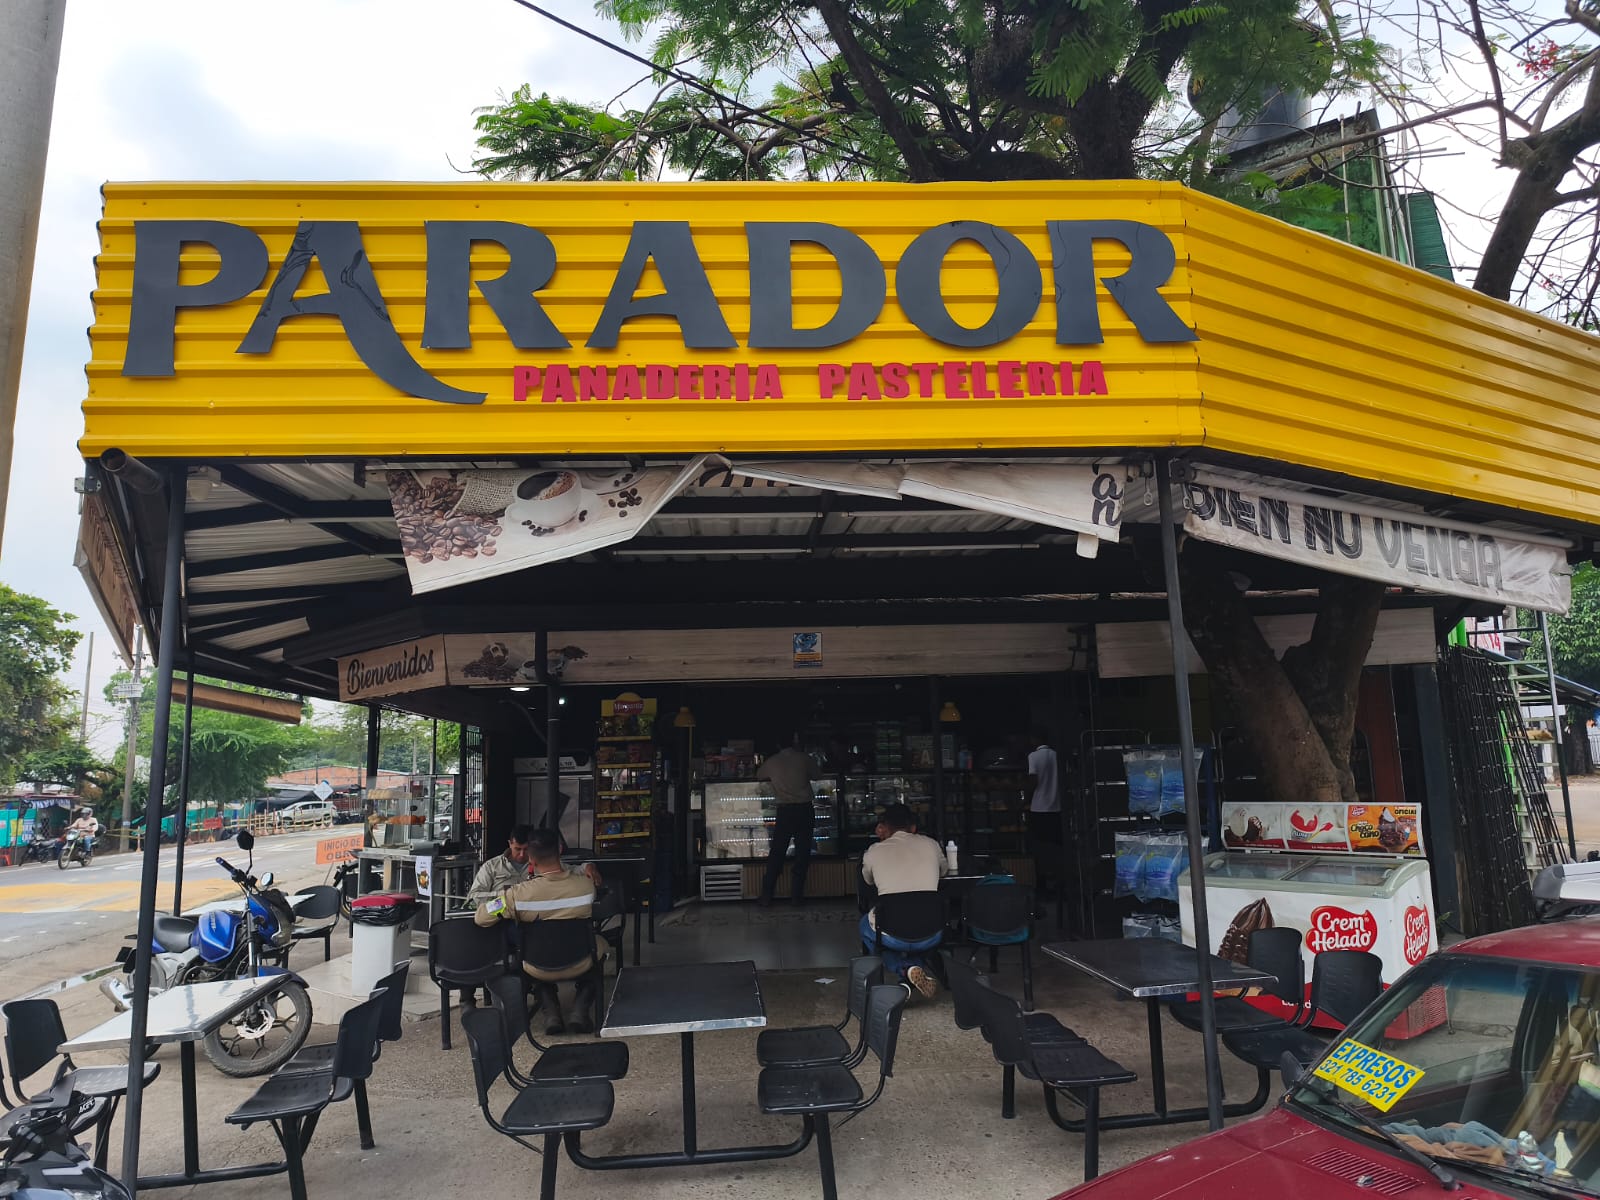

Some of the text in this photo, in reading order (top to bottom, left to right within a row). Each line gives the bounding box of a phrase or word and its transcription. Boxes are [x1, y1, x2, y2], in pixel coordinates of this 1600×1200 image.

[122, 219, 1200, 404] PARADOR
[513, 361, 1109, 402] PANADERIA PASTELERIA
[1373, 517, 1504, 592] VENGA
[346, 644, 435, 695] Bienvenidos
[323, 837, 361, 852] INICIO DE
[1311, 929, 1371, 949] Helado
[1316, 911, 1365, 934] Crem
[1319, 1059, 1398, 1104] 321 785 6231
[1332, 1041, 1416, 1088] EXPRESOS
